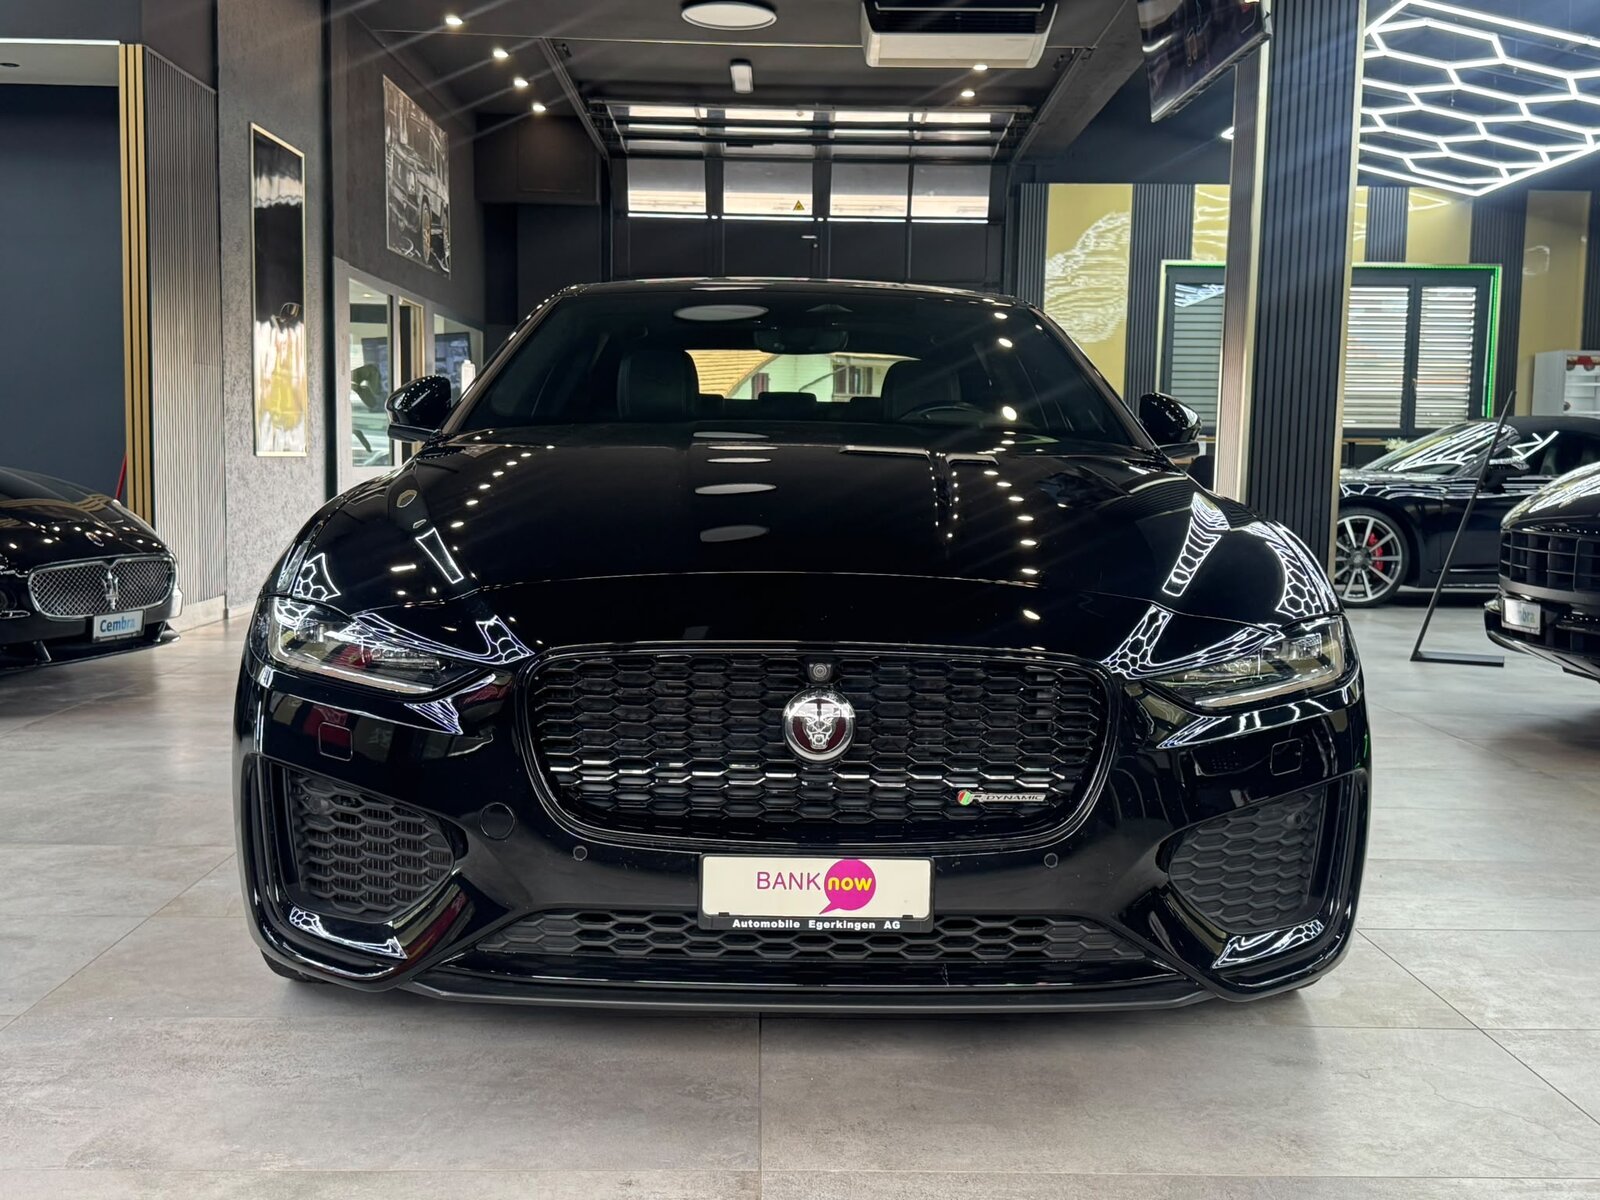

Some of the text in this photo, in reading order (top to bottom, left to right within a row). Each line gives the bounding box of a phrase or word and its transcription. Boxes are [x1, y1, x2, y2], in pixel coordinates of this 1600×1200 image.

[100, 616, 136, 633] Cembra
[756, 871, 873, 892] BANK now
[732, 919, 901, 931] Automobile Egerkingen AG
